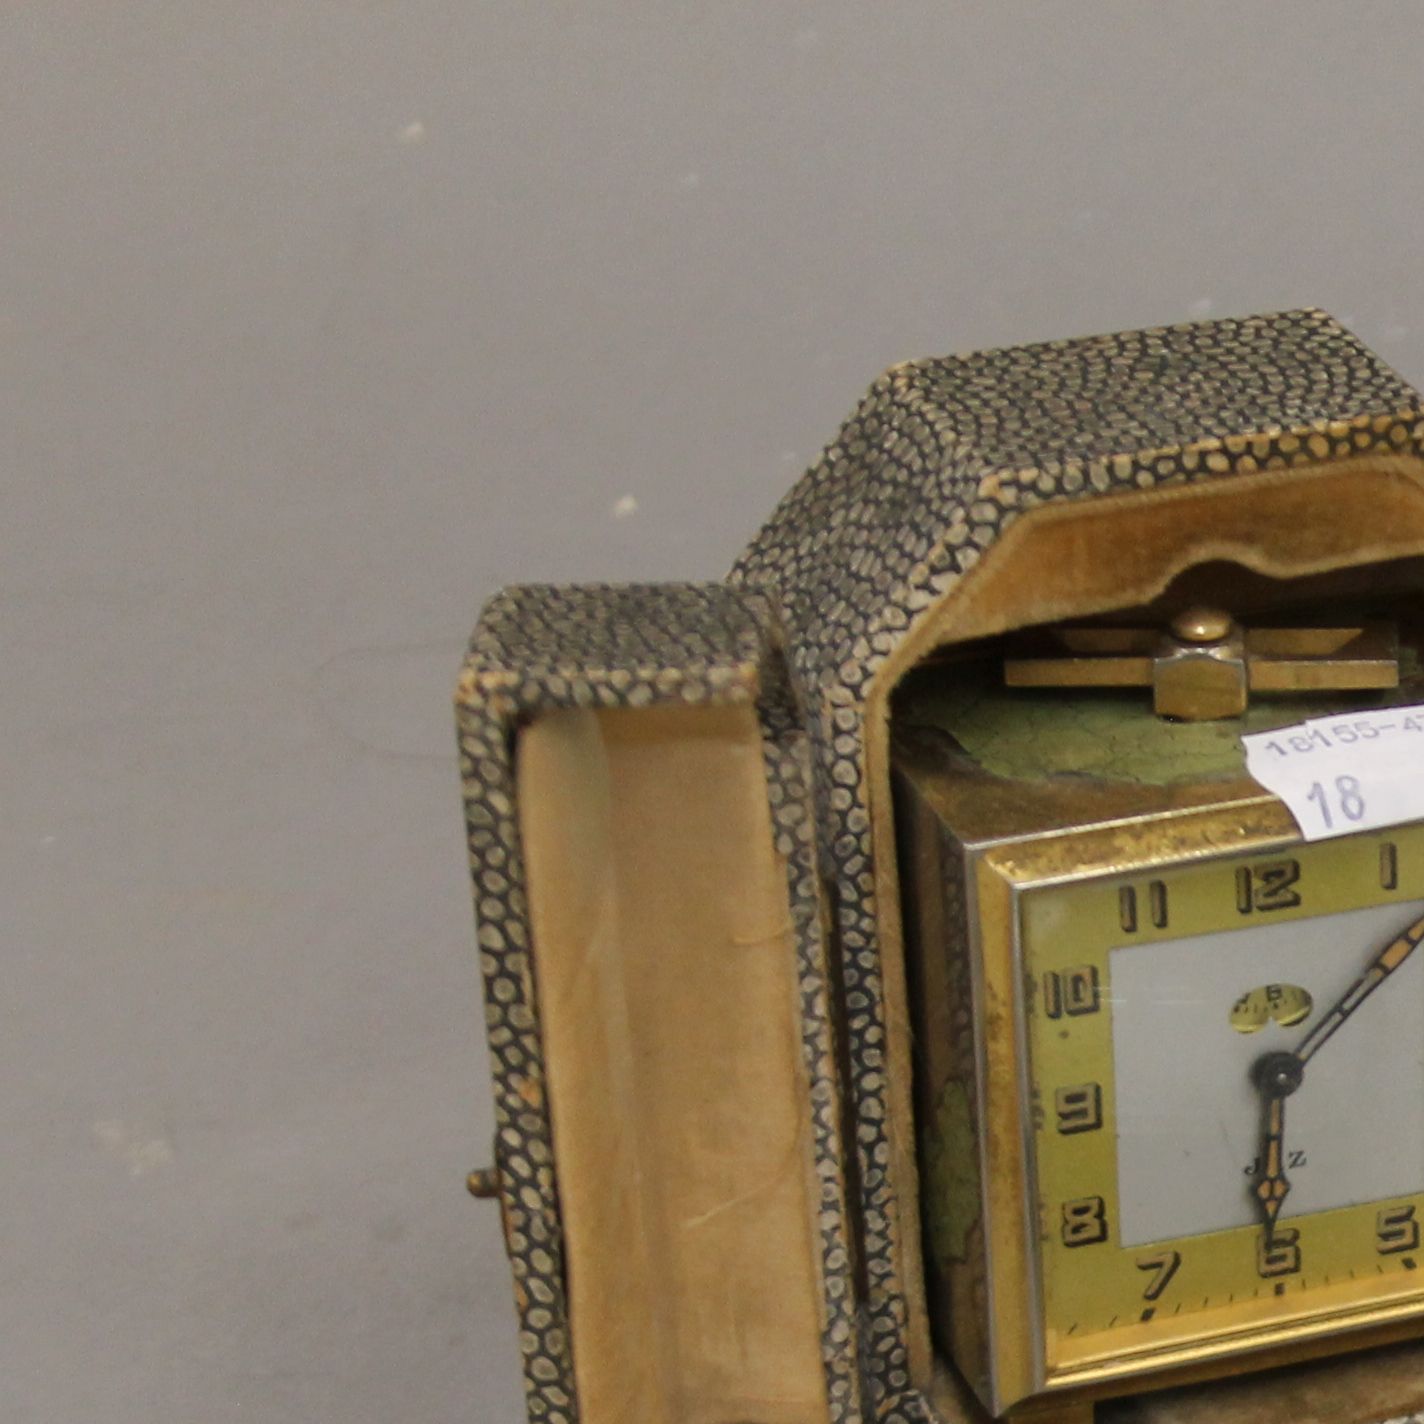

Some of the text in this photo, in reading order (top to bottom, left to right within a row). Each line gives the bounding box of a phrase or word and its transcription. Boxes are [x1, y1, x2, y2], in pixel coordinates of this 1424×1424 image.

[1307, 774, 1365, 829] 18
[1235, 859, 1301, 914] 12
[1379, 843, 1397, 890] 1
[1119, 880, 1168, 932] 11
[1043, 965, 1100, 1019] 10
[1055, 1082, 1103, 1135] 9
[1244, 1150, 1307, 1175] JZ
[1061, 1196, 1108, 1248] 8
[1376, 1205, 1420, 1254] 5
[1136, 1250, 1182, 1300] 7
[1256, 1228, 1300, 1278] 6
